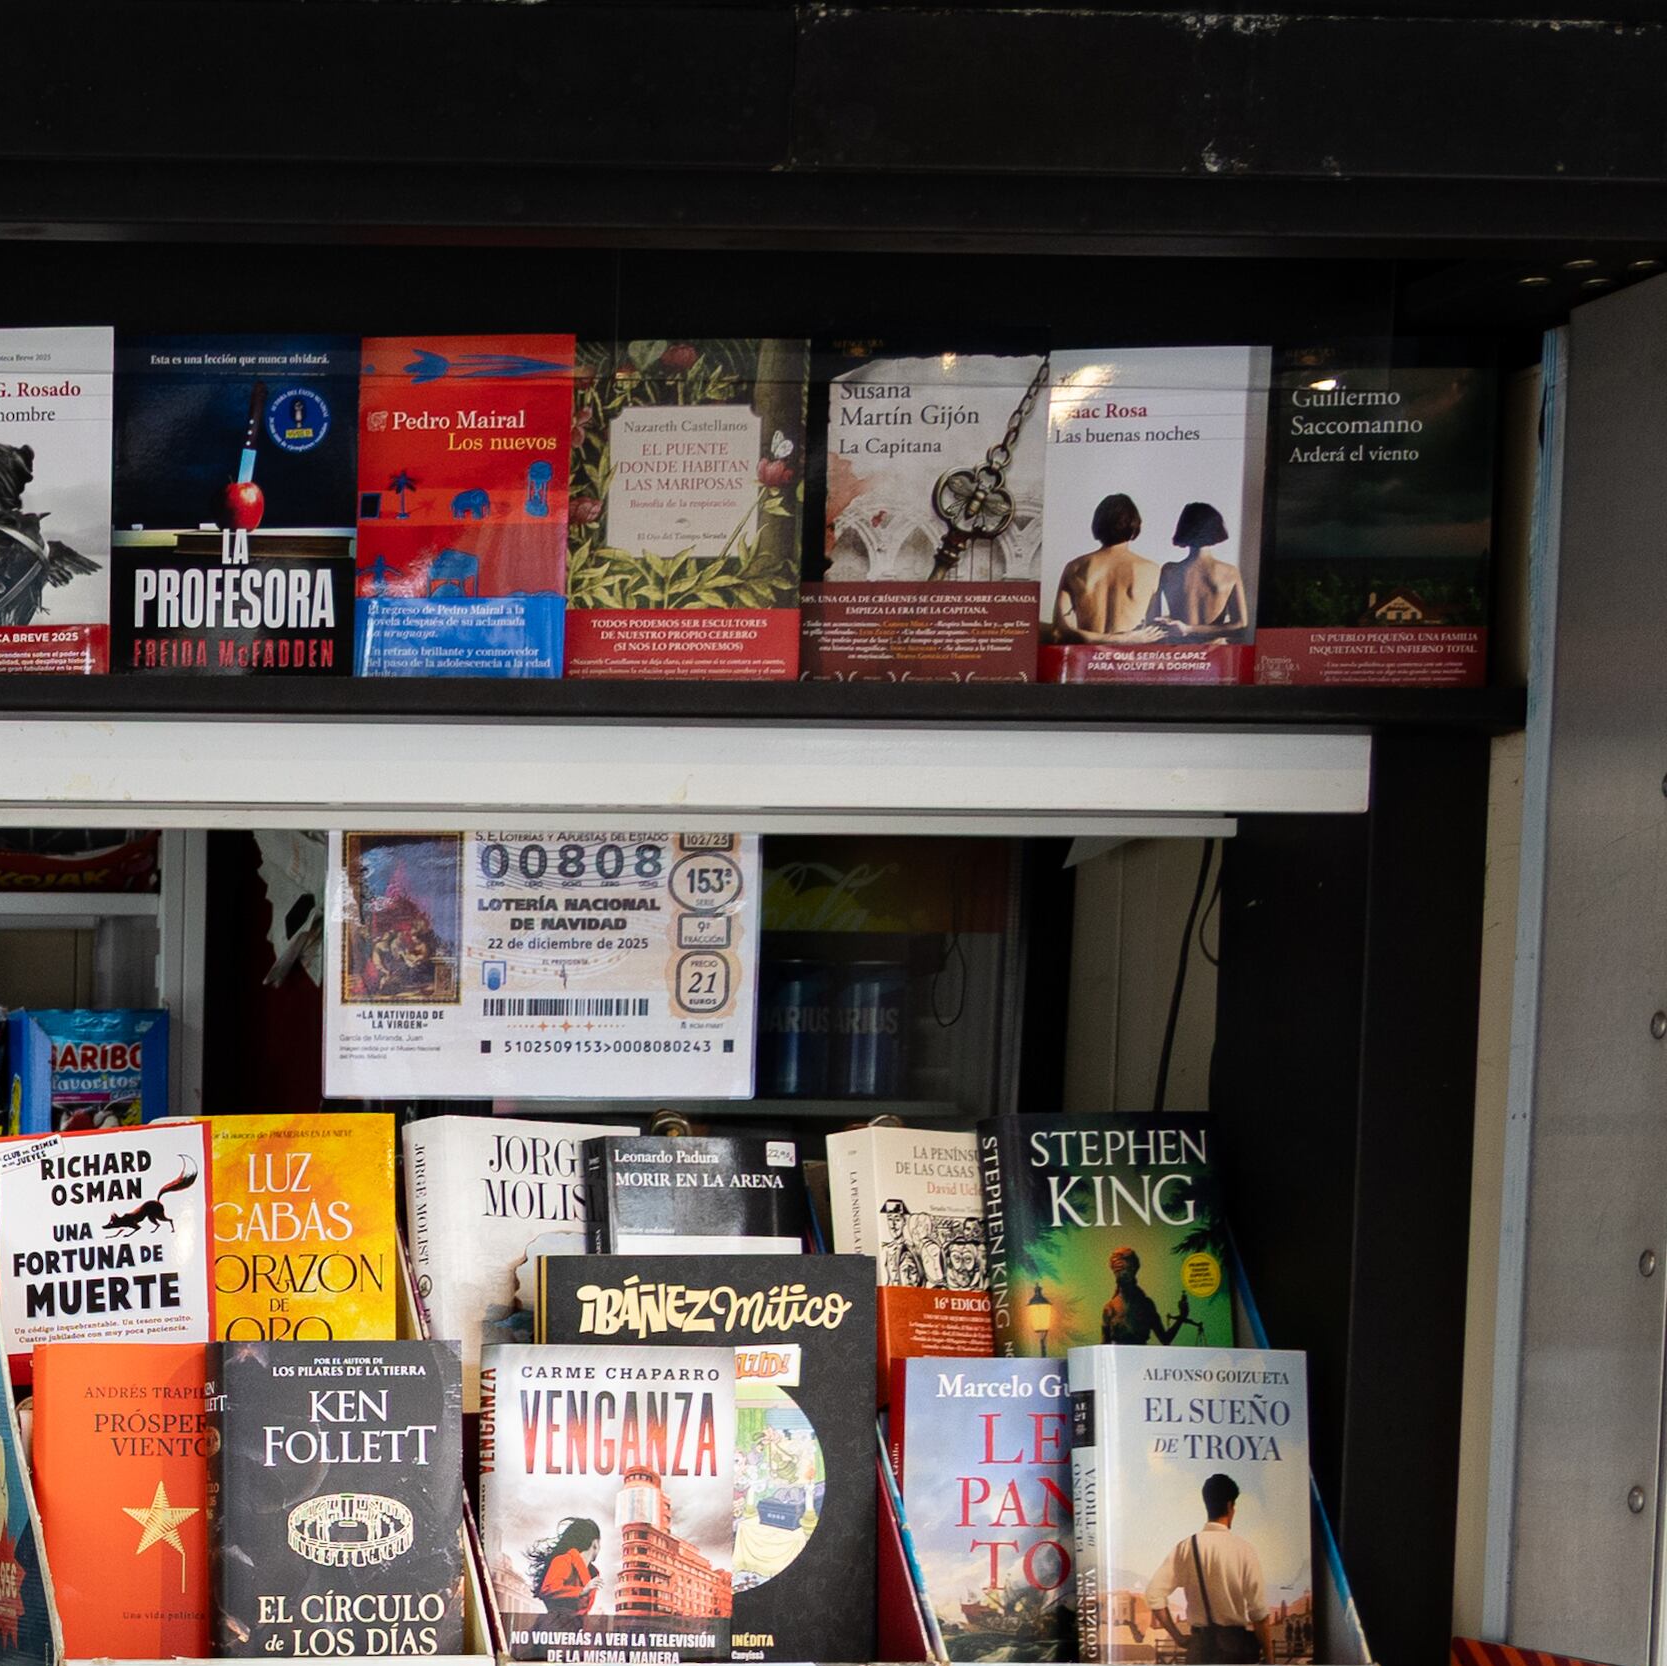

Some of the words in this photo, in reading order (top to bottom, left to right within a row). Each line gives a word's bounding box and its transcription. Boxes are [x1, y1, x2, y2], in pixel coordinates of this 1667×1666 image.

[17, 381, 81, 399] Rosado
[392, 411, 452, 430] Pedro
[457, 410, 525, 429] Mairal
[840, 406, 913, 427] Martín
[920, 404, 980, 431] Gijón
[448, 433, 483, 451] Los
[490, 435, 557, 451] nuevos
[839, 438, 859, 454] La
[864, 437, 941, 456] Capitana
[222, 529, 249, 565] LA
[135, 568, 334, 628] PROFESORA
[478, 897, 558, 912] LOTERÍA
[565, 898, 660, 911] NACIONAL
[510, 917, 535, 931] DE
[542, 917, 626, 931] NAVIDAD
[488, 938, 503, 949] 22
[508, 938, 523, 949] de
[527, 938, 592, 949] diciembre
[596, 938, 612, 949] de
[617, 938, 648, 949] 2025
[689, 972, 716, 993] 21
[504, 1040, 711, 1053] 5102509153>0008080243
[1031, 1130, 1206, 1168] STEPHEN
[40, 1149, 152, 1180] RICHARD
[249, 1153, 311, 1193] LUZ
[51, 1178, 142, 1205] OSMAN
[1047, 1175, 1196, 1228] KING
[53, 1223, 93, 1242] UNA
[13, 1245, 136, 1278] FORTUNA
[141, 1245, 163, 1262] DE
[26, 1272, 181, 1318] MUERTE
[521, 1366, 596, 1380] CARME
[606, 1367, 720, 1381] CHAPARRO
[310, 1391, 388, 1424] KEN
[1144, 1398, 1182, 1425] EL
[1188, 1394, 1291, 1427] SUEÑO
[263, 1426, 436, 1467] FOLLETT
[521, 1390, 717, 1476] VENGANZA
[1154, 1436, 1178, 1454] DE
[1183, 1433, 1283, 1462] TROYA
[258, 1596, 293, 1624] EL
[301, 1591, 444, 1623] CÍRCULO
[265, 1636, 283, 1651] de
[293, 1628, 355, 1655] LOS
[366, 1624, 437, 1654] DÍAS
